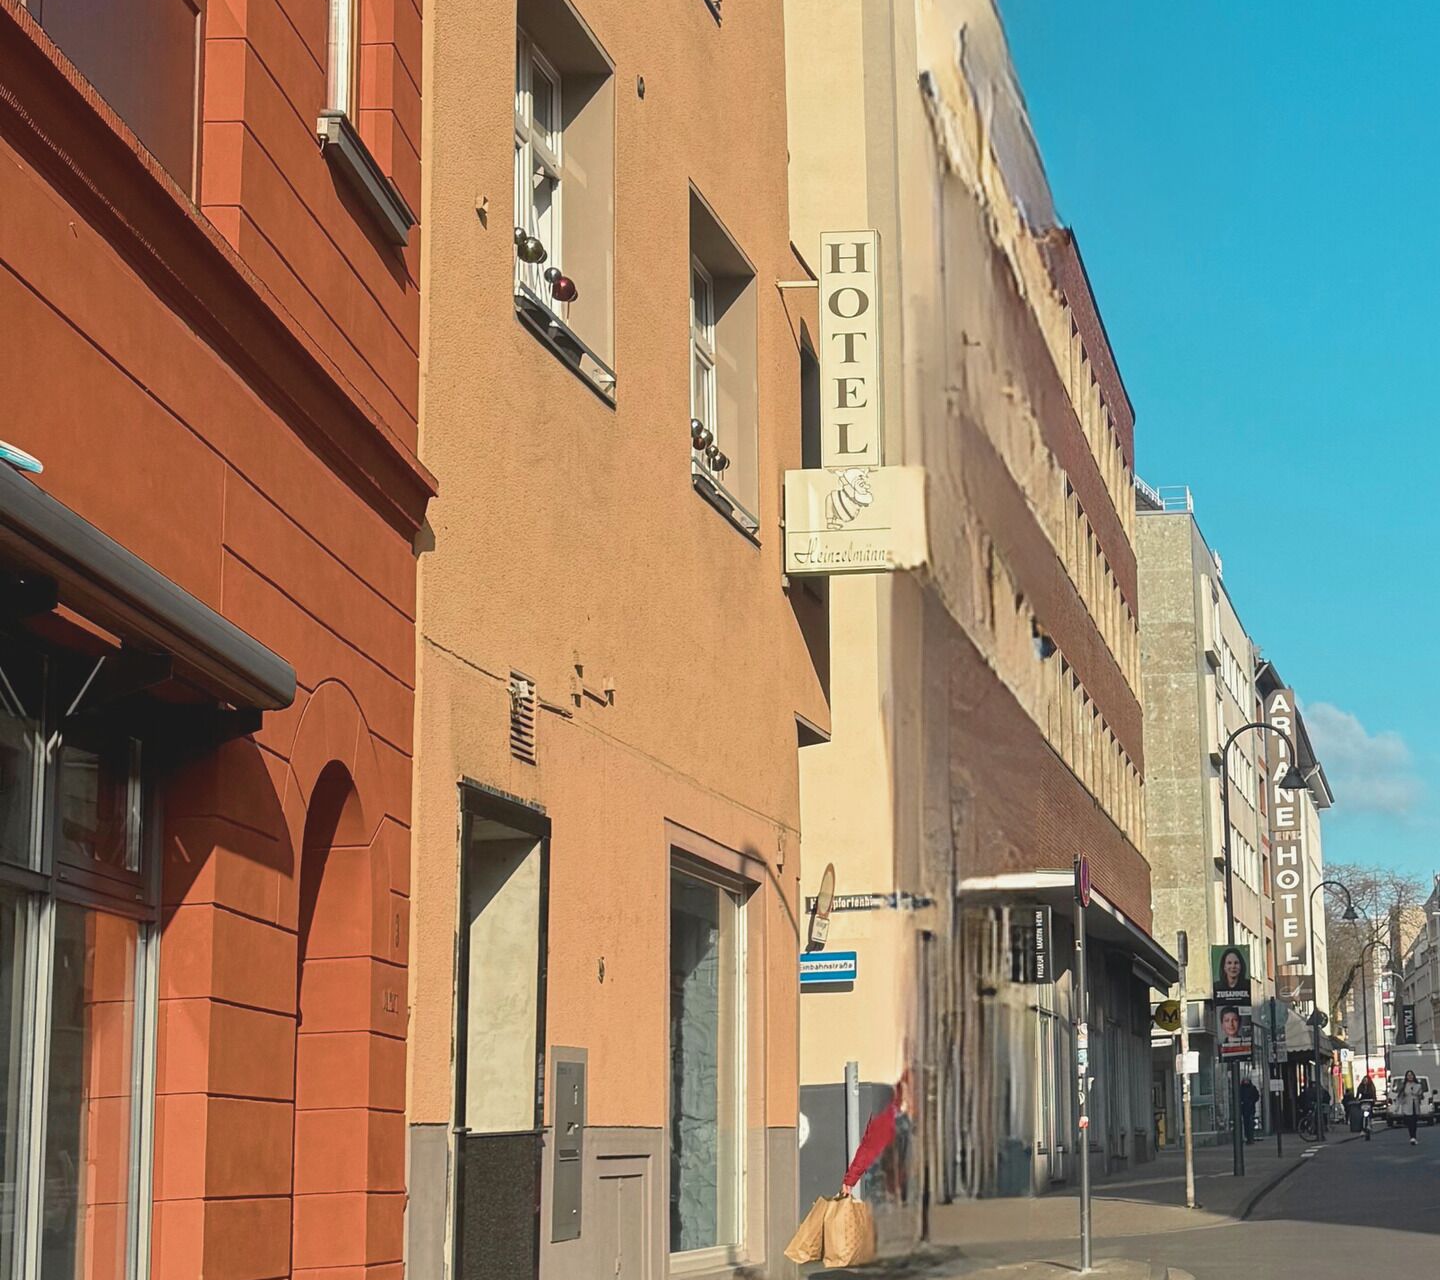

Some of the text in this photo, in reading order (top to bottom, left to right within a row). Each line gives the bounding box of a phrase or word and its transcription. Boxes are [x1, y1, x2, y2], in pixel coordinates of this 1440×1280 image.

[825, 242, 872, 455] HOTEL
[1269, 694, 1295, 827] ARIANE
[1276, 846, 1300, 962] HOTEL
